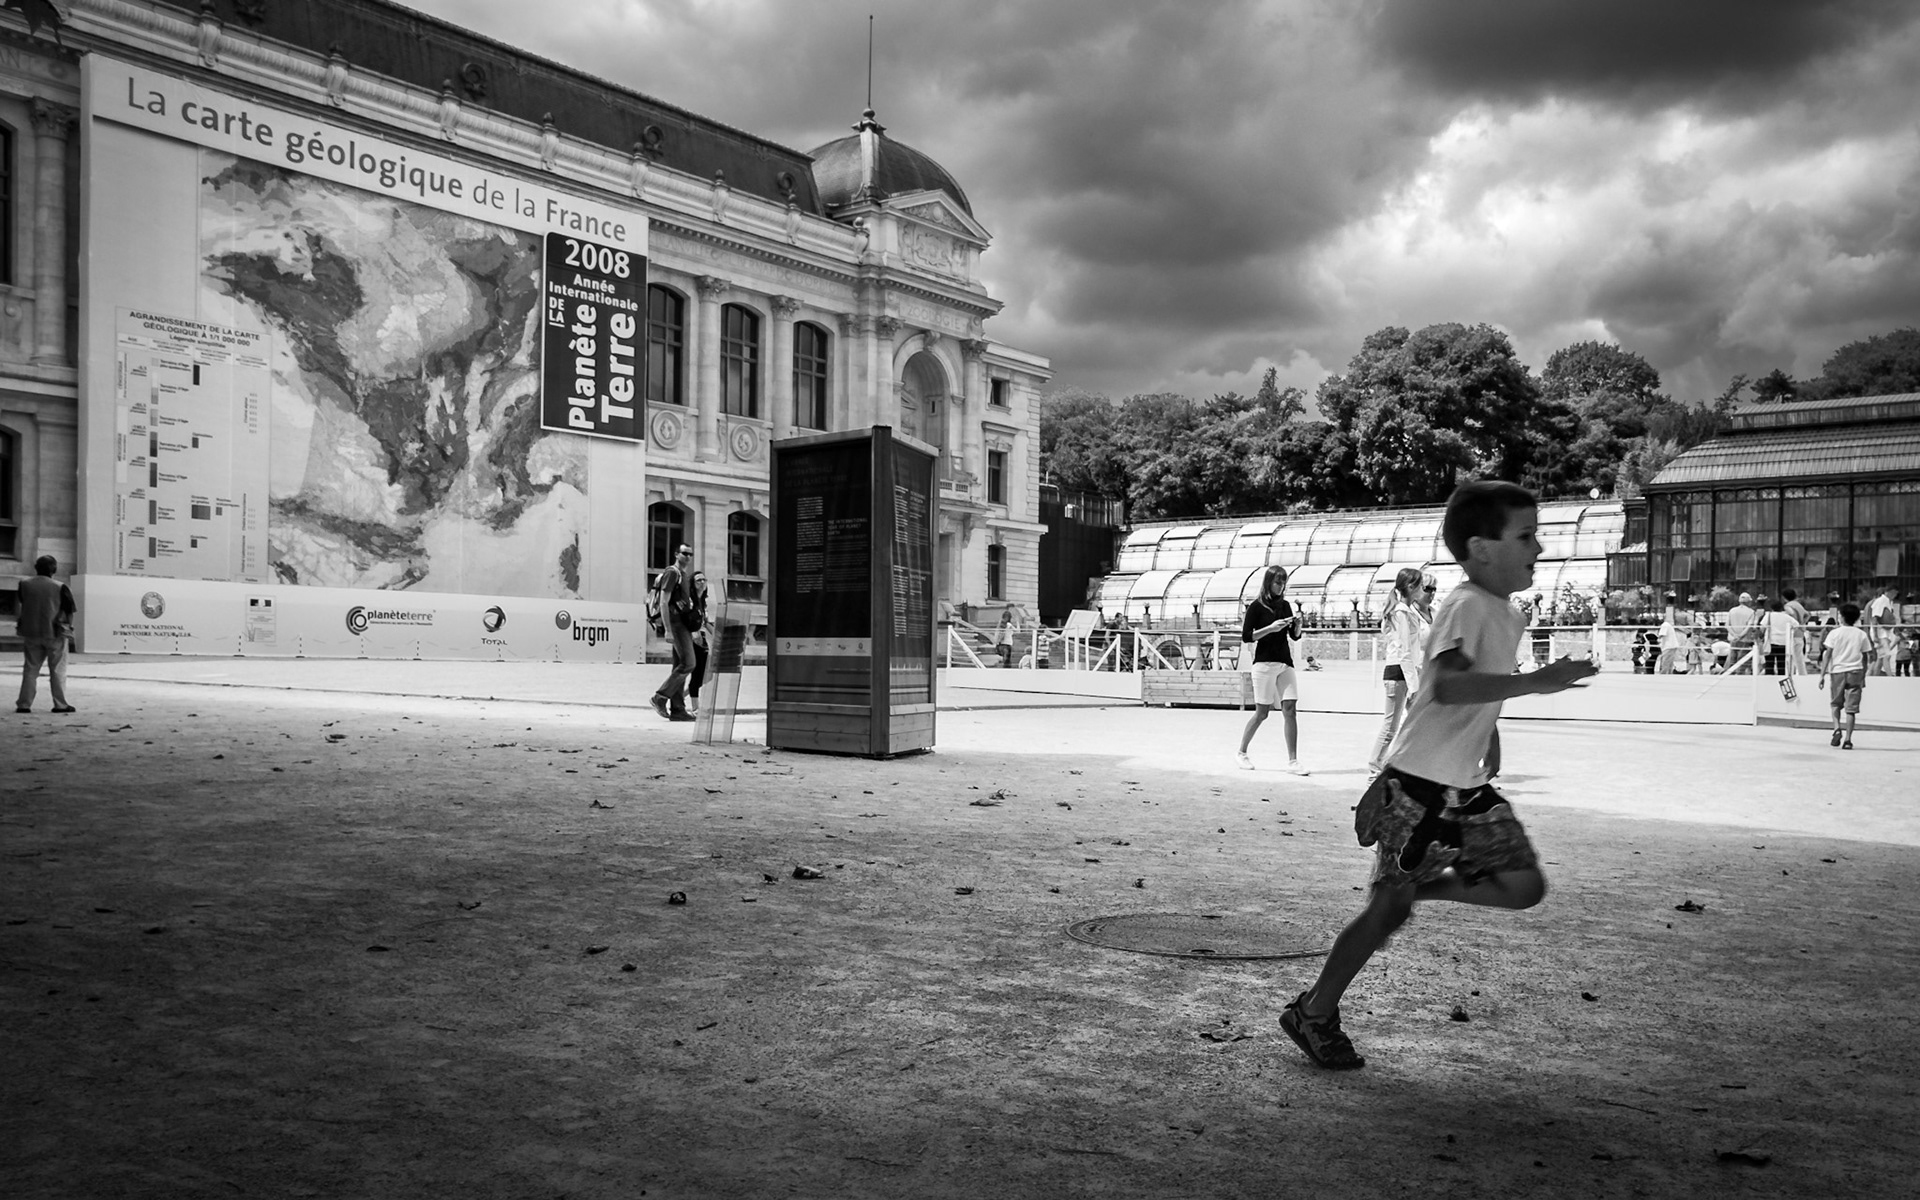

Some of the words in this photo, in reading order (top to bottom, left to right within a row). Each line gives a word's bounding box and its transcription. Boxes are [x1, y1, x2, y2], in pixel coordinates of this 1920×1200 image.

[128, 76, 166, 116] La
[181, 100, 274, 147] carte
[285, 131, 464, 197] géologique
[472, 179, 505, 210] de
[515, 188, 536, 218] la
[546, 198, 627, 242] France
[564, 239, 631, 279] 2008
[549, 281, 639, 312] Internationale
[573, 274, 616, 294] Année
[549, 297, 565, 311] DE
[549, 310, 565, 324] LA
[907, 304, 961, 330] ZOOLOGIE
[129, 311, 207, 331] AGRANDISSEMENT
[222, 328, 233, 336] LA
[234, 331, 260, 341] CARTE
[143, 321, 199, 338] GÉOLOGIQUE
[210, 333, 220, 341] 1/1
[222, 336, 236, 344] 000
[237, 338, 251, 347] 000
[567, 304, 598, 430] Planète
[601, 312, 636, 424] Terre
[367, 609, 433, 621] planèteterre
[573, 620, 609, 646] brgm
